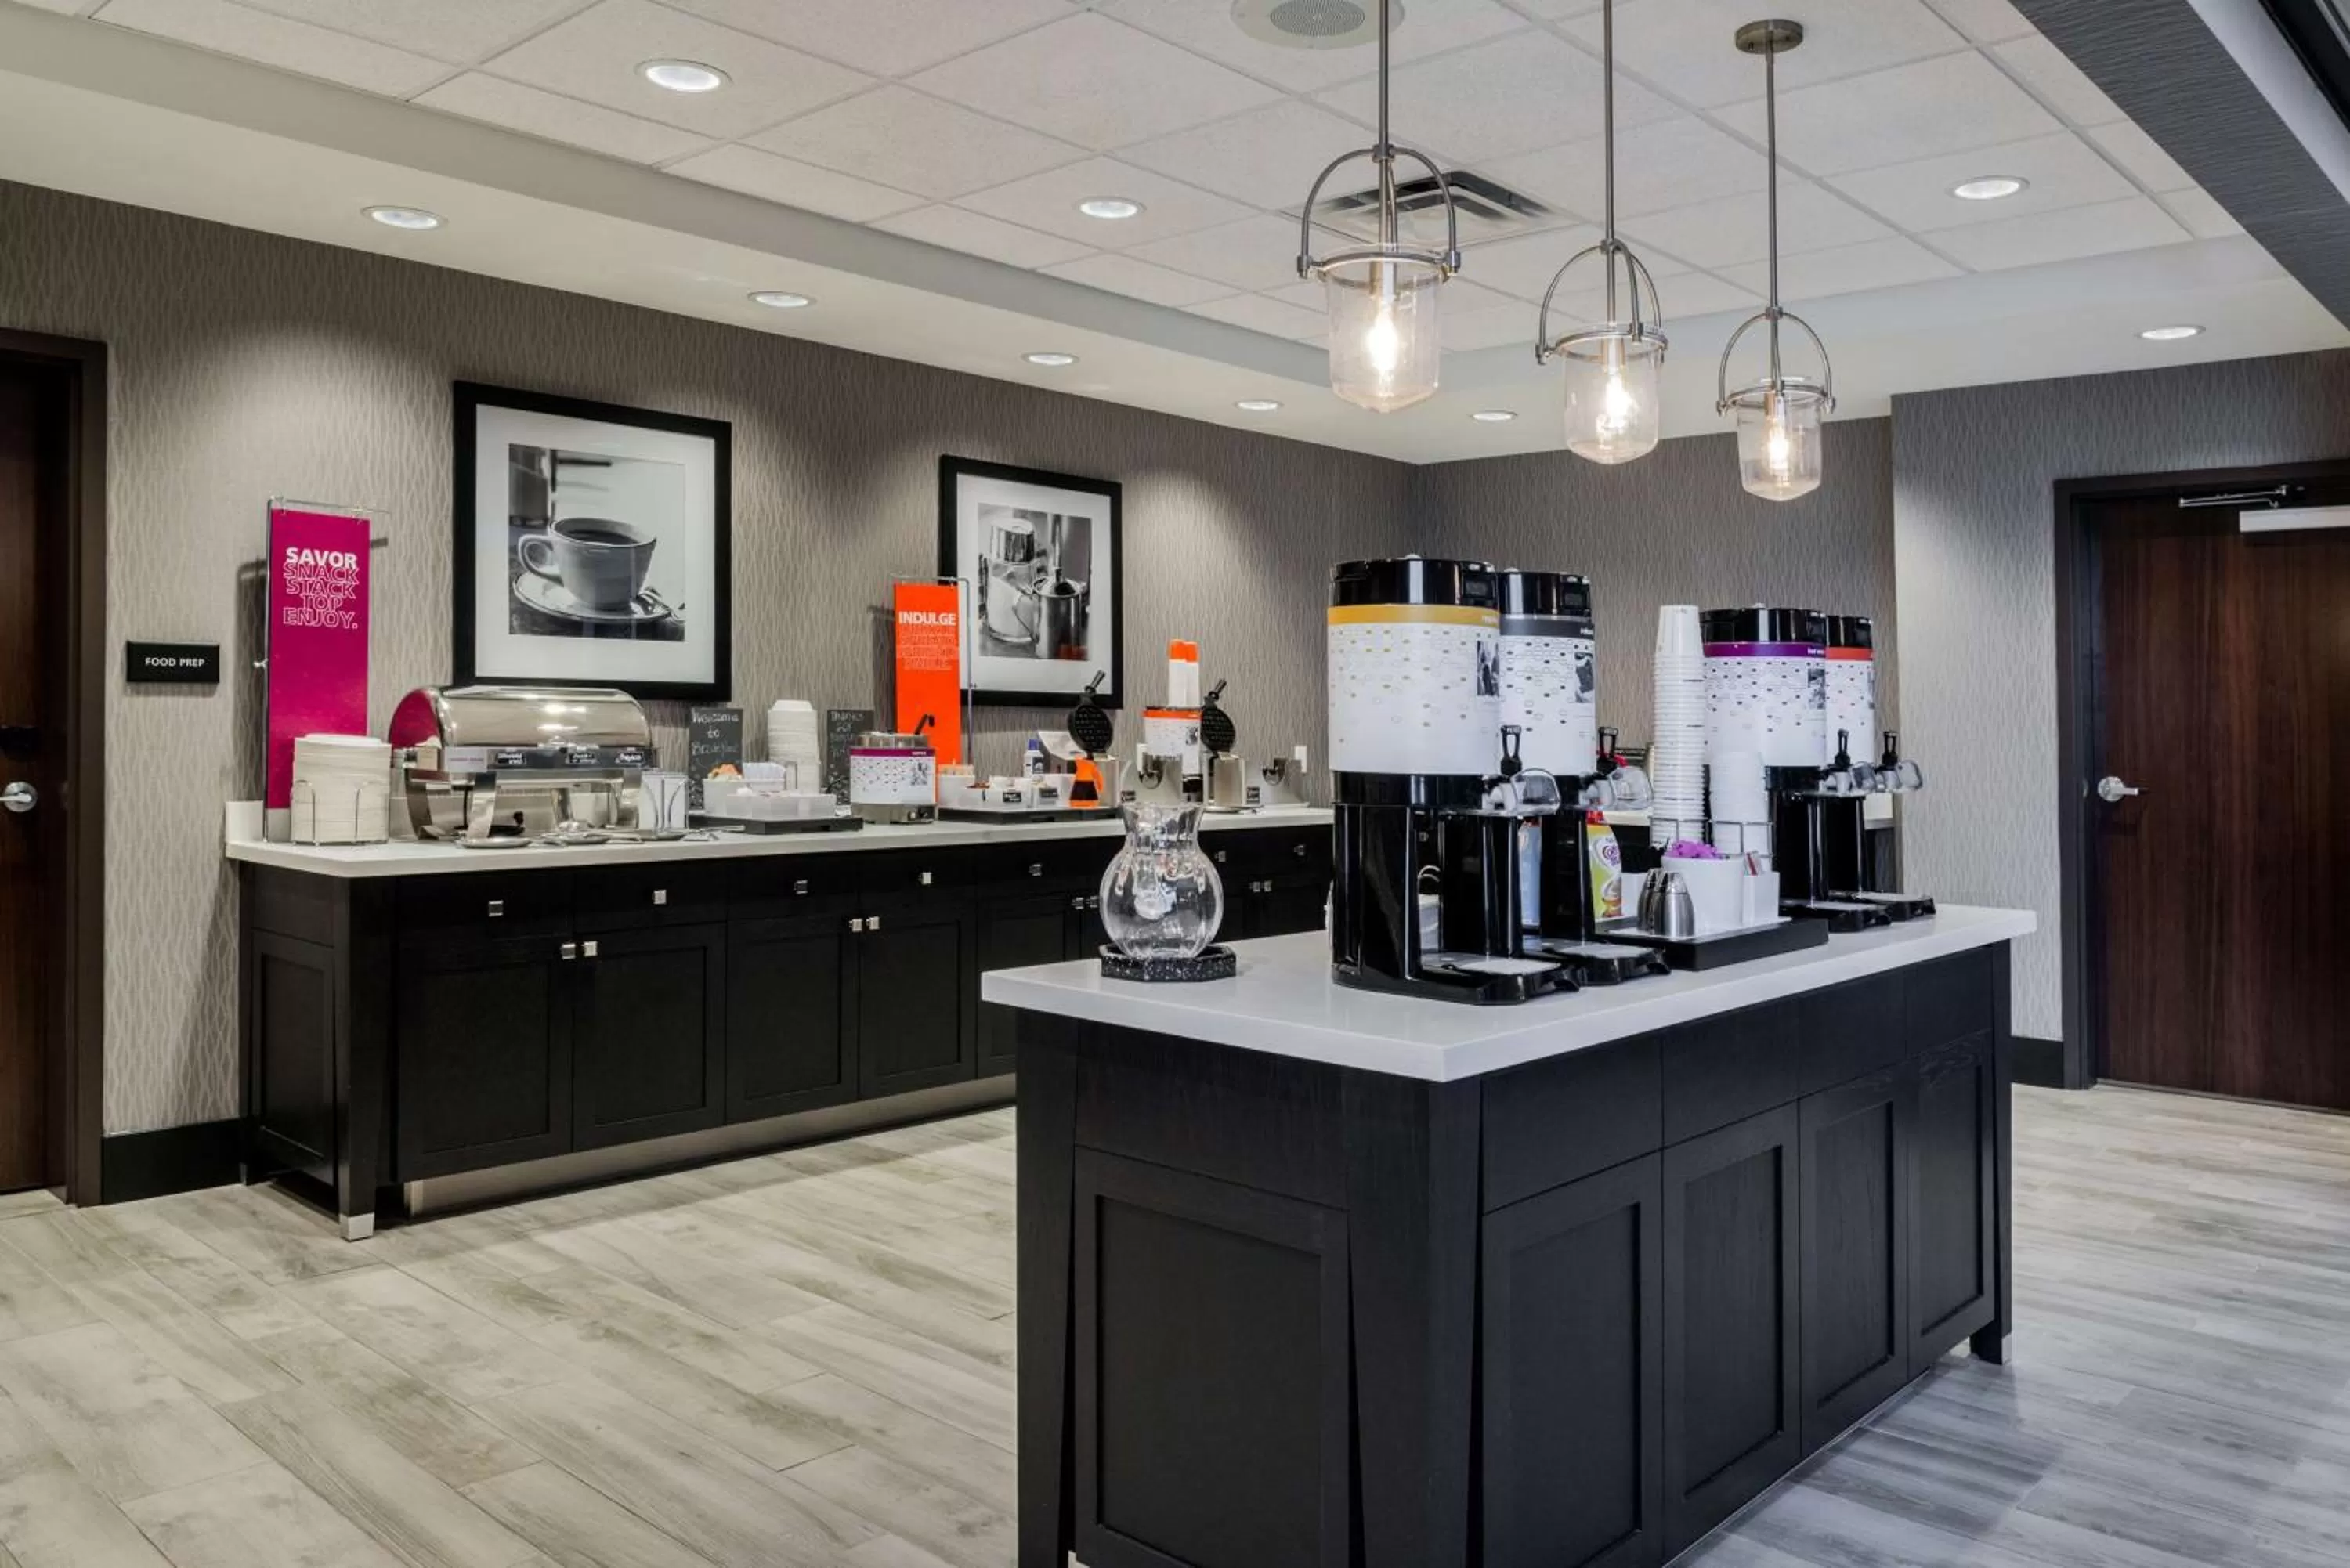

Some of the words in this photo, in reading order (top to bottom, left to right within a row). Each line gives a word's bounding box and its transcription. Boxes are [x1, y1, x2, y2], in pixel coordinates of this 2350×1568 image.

[286, 547, 357, 570] SAVOR
[283, 561, 360, 586] SNACK
[286, 577, 356, 599] STACK
[299, 593, 343, 612] TOP
[283, 606, 358, 630] ENJOY.
[898, 611, 956, 626] INDULGE
[145, 657, 176, 667] FOOD
[179, 658, 205, 667] PREP
